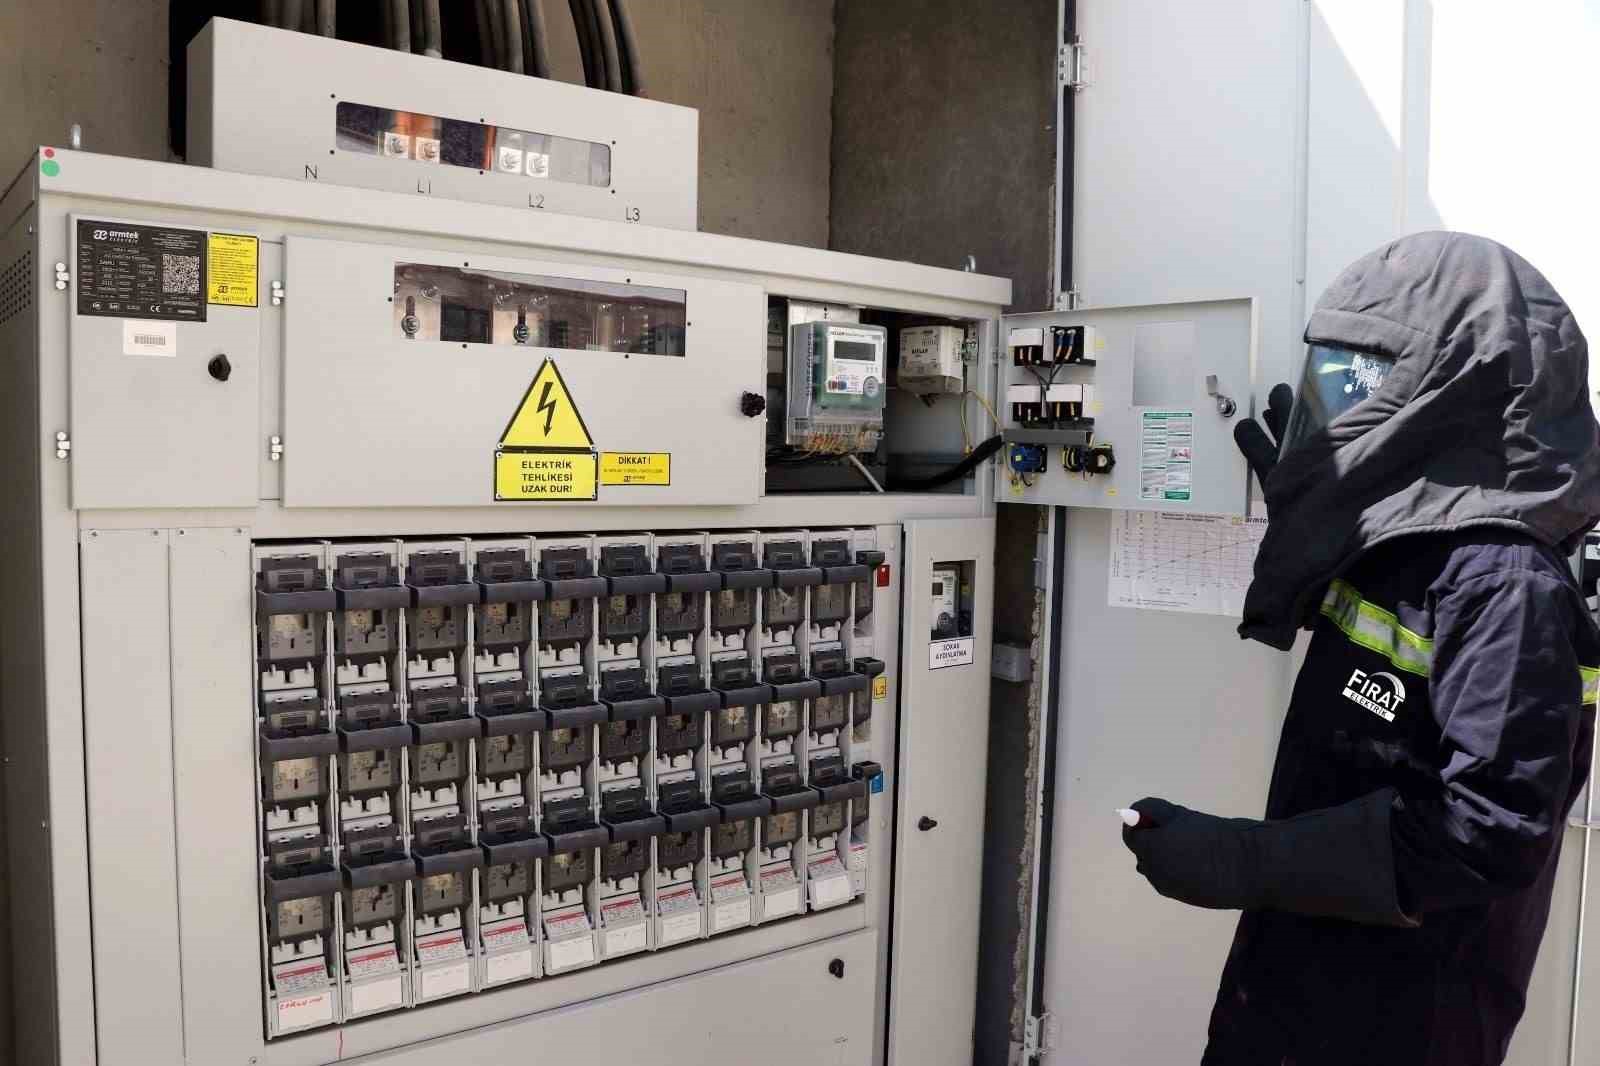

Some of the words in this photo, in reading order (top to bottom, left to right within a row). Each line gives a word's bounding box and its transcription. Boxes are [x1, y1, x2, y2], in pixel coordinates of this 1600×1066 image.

[304, 164, 318, 179] N
[417, 178, 432, 194] L1
[528, 193, 545, 209] L2
[625, 207, 641, 222] L3
[109, 230, 139, 239] armtek
[521, 460, 572, 469] ELEKTRİK
[521, 472, 573, 482] TEHLİKESİ
[521, 485, 548, 493] UZAK
[549, 484, 573, 493] DUR!
[1347, 668, 1404, 711] FIRAT
